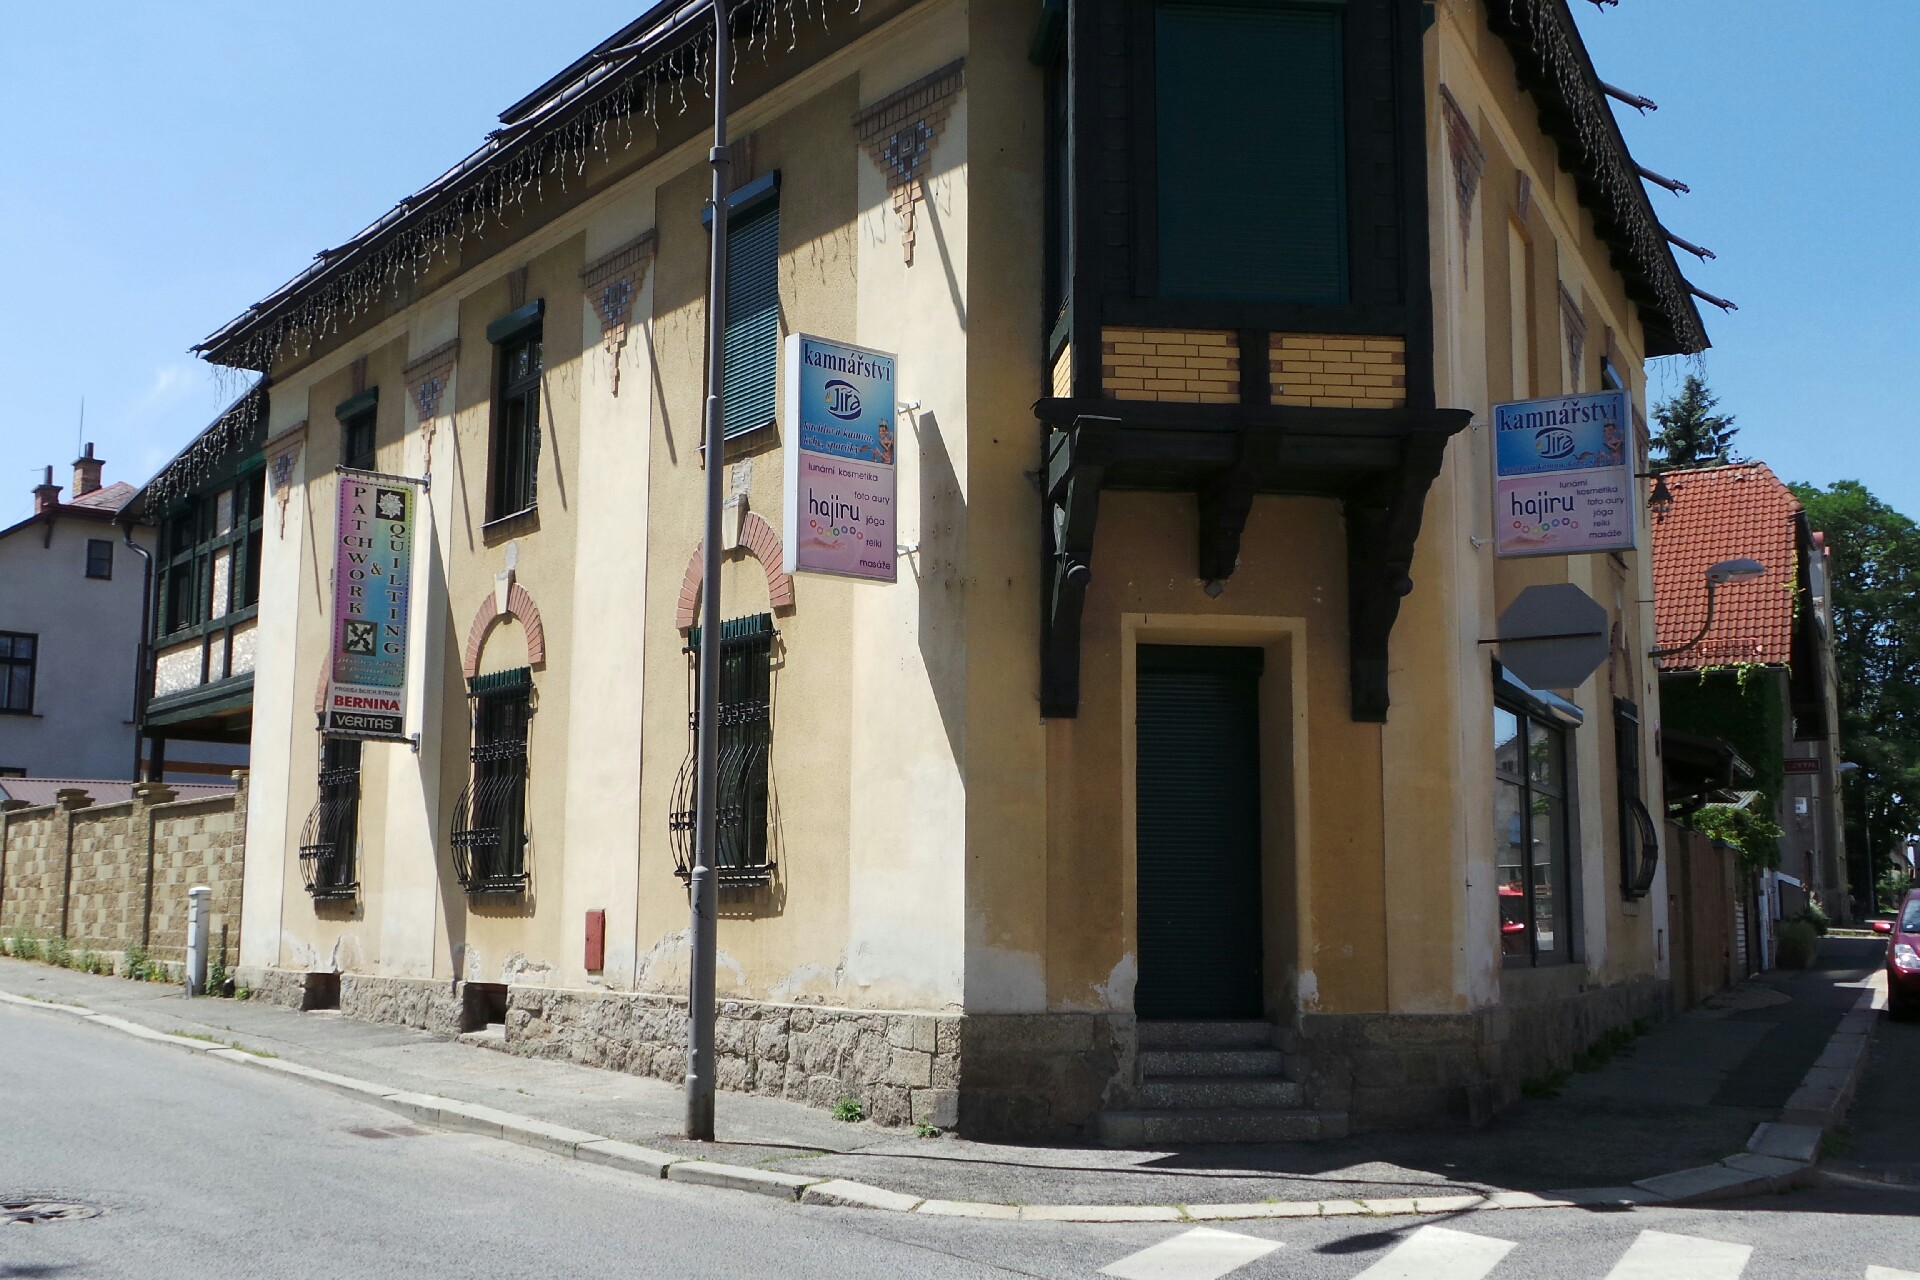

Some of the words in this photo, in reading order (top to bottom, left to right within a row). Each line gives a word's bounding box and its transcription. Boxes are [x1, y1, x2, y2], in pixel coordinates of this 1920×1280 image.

[804, 343, 891, 382] kamnářství
[1500, 397, 1618, 431] kamnářství
[808, 463, 836, 475] lunární
[838, 467, 879, 482] kosmetika
[854, 490, 870, 501] foto
[872, 493, 890, 505] aury
[1576, 486, 1618, 496] kosmetika
[809, 487, 860, 527] hajiru
[1511, 491, 1575, 525] hajiru
[1605, 497, 1625, 506] aury
[865, 515, 885, 526] jóga
[1593, 508, 1614, 518] jóga
[866, 539, 882, 548] reiki
[370, 562, 383, 576] &
[859, 558, 891, 570] masáže
[383, 523, 406, 654] QUILTING
[334, 694, 400, 712] BERNINA
[336, 714, 394, 730] VERITAS
